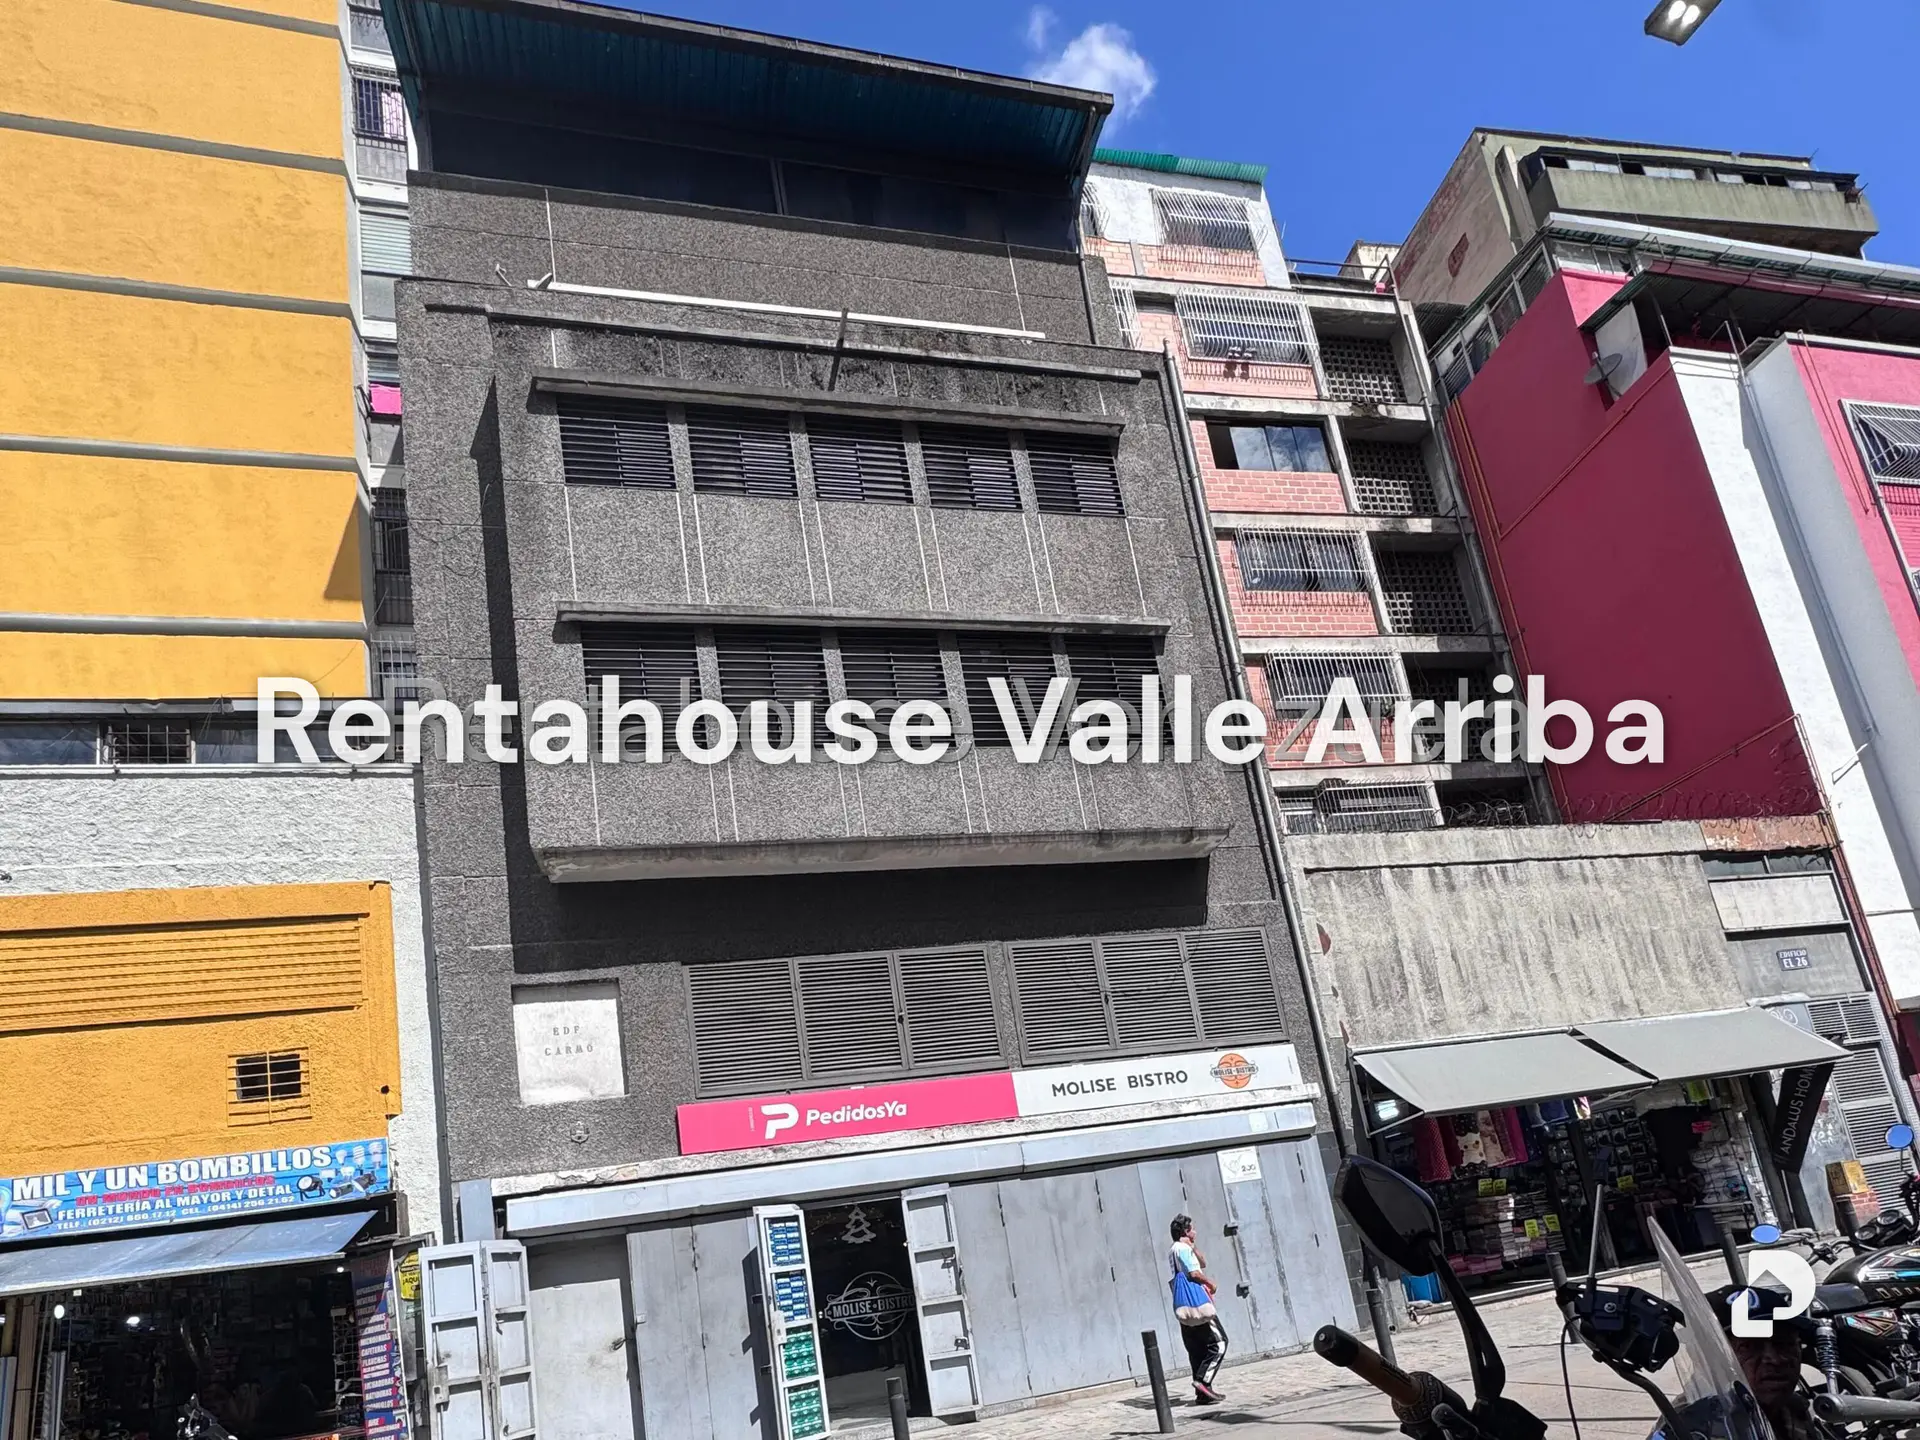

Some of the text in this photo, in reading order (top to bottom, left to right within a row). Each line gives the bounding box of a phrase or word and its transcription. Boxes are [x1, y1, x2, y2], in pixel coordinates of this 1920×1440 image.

[1783, 957, 1808, 968] EL 26
[553, 1026, 580, 1036] EDF
[544, 1044, 593, 1056] CARMO
[1052, 1070, 1188, 1097] MOLISE BISTRO
[806, 1101, 907, 1126] PedidosYa
[1780, 1100, 1804, 1154] ANDALUS
[12, 1146, 332, 1200] MIL Y UN BOMBILLOS
[57, 1184, 292, 1221] FERRETERÍA AL MAYOR Y DETAL
[833, 1295, 915, 1317] MOLISE BISTRO
